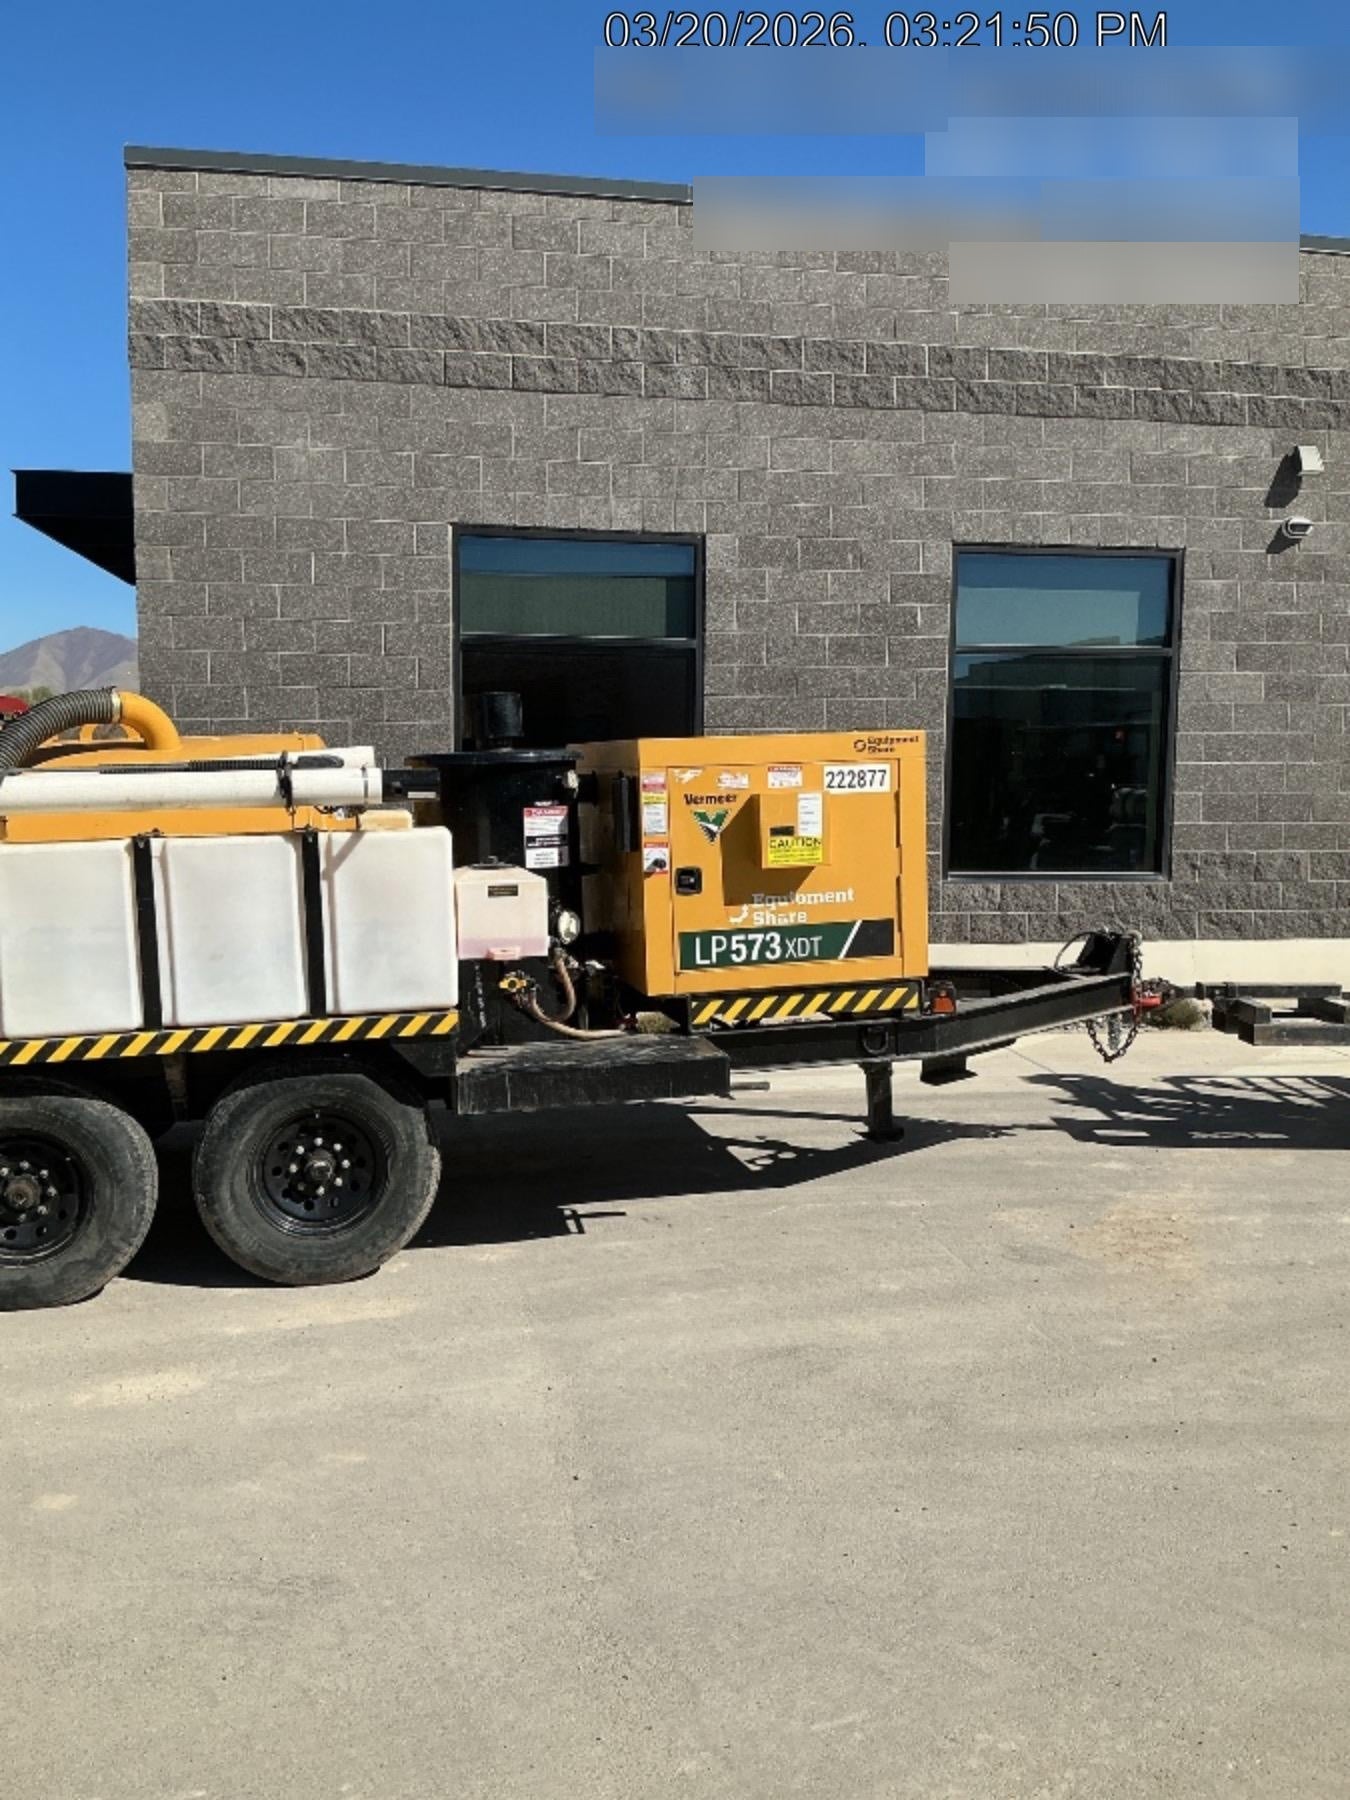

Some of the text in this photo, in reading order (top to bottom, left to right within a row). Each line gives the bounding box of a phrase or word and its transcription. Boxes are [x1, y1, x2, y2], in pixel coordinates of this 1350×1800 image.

[825, 769, 888, 790] 222877
[684, 793, 738, 805] Vermeer
[770, 838, 822, 849] CAUTION
[753, 911, 807, 926] Share
